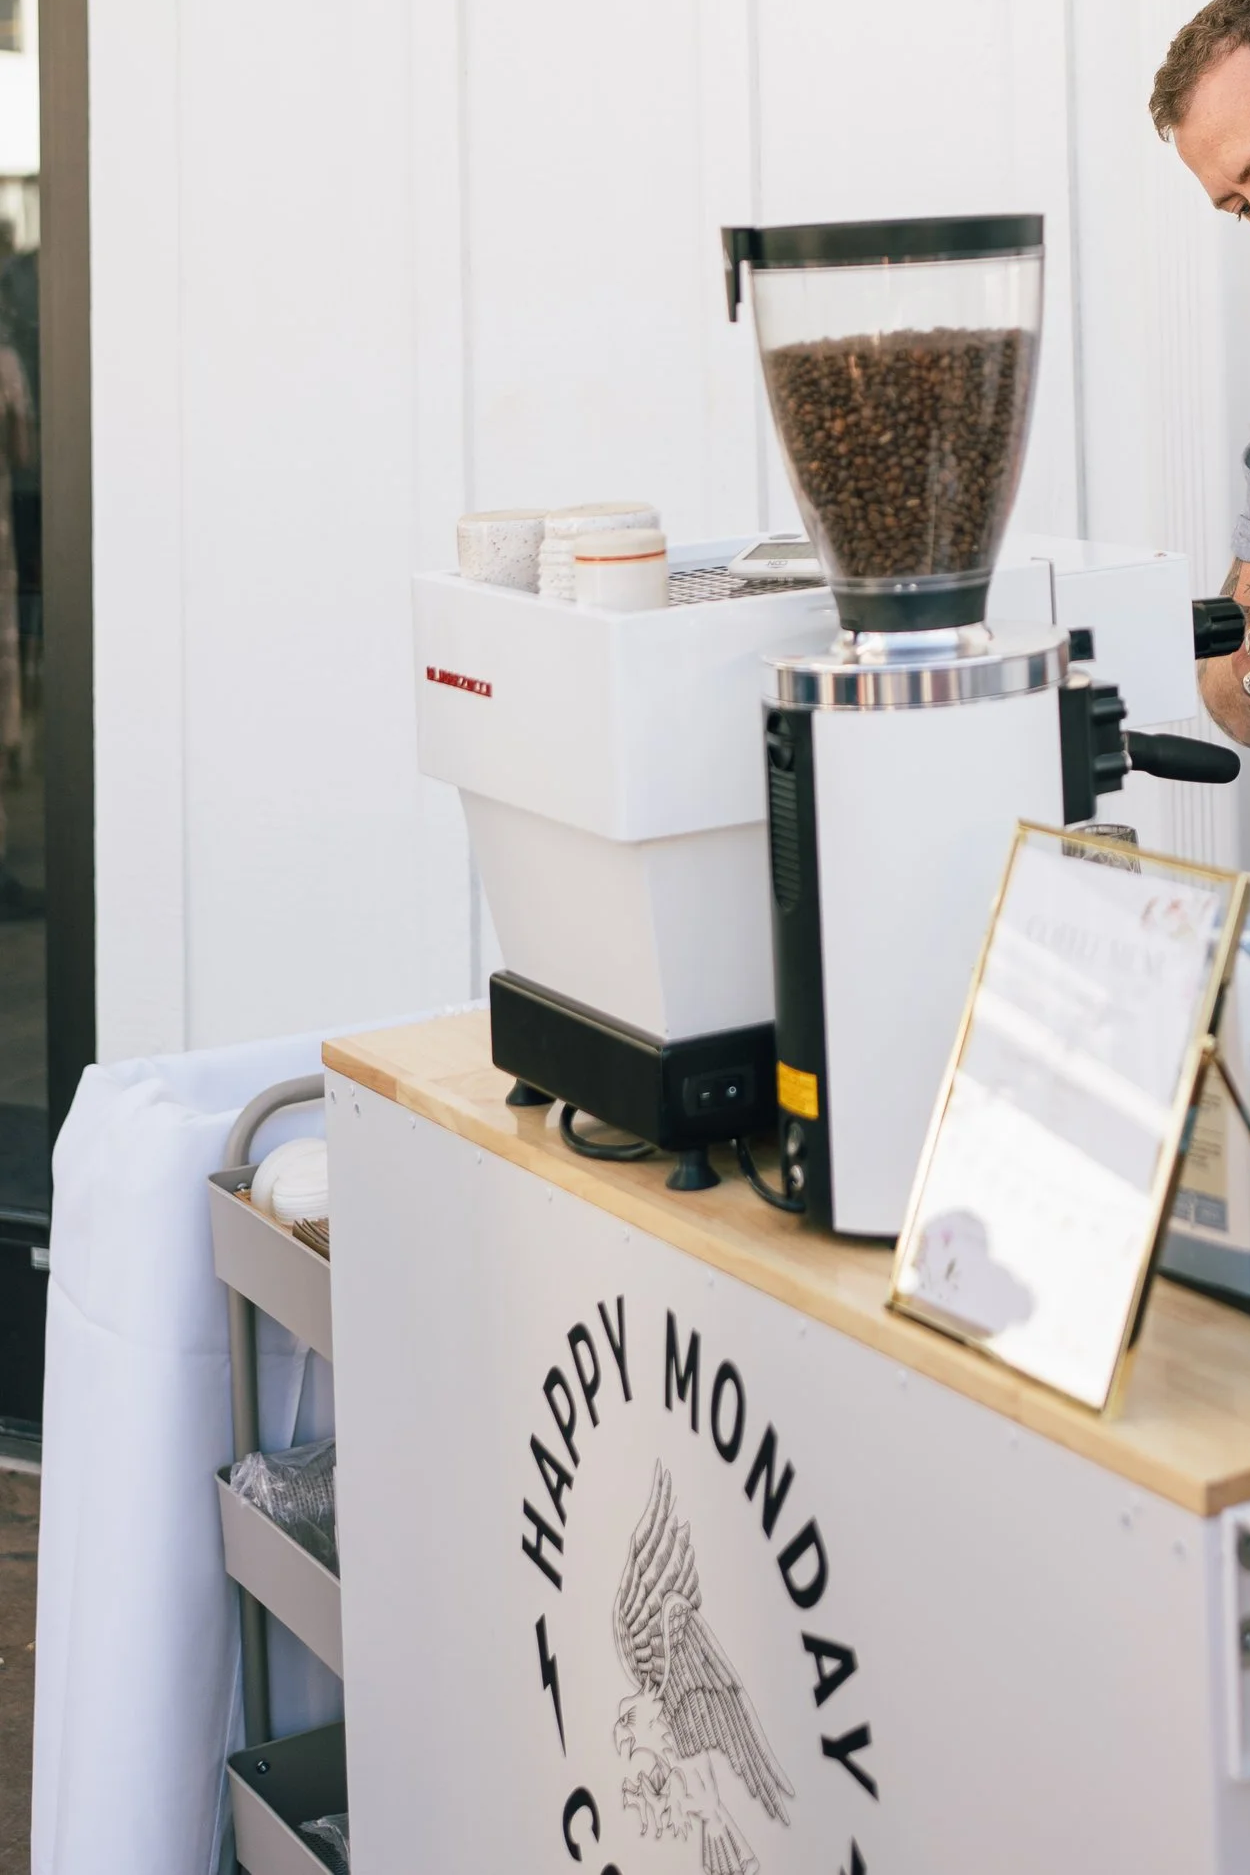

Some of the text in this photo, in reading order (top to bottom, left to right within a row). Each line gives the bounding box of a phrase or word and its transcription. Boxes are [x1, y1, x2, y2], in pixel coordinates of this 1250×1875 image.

[520, 1294, 880, 1802] HAPPY MONDAY
[562, 1785, 624, 1875] C
